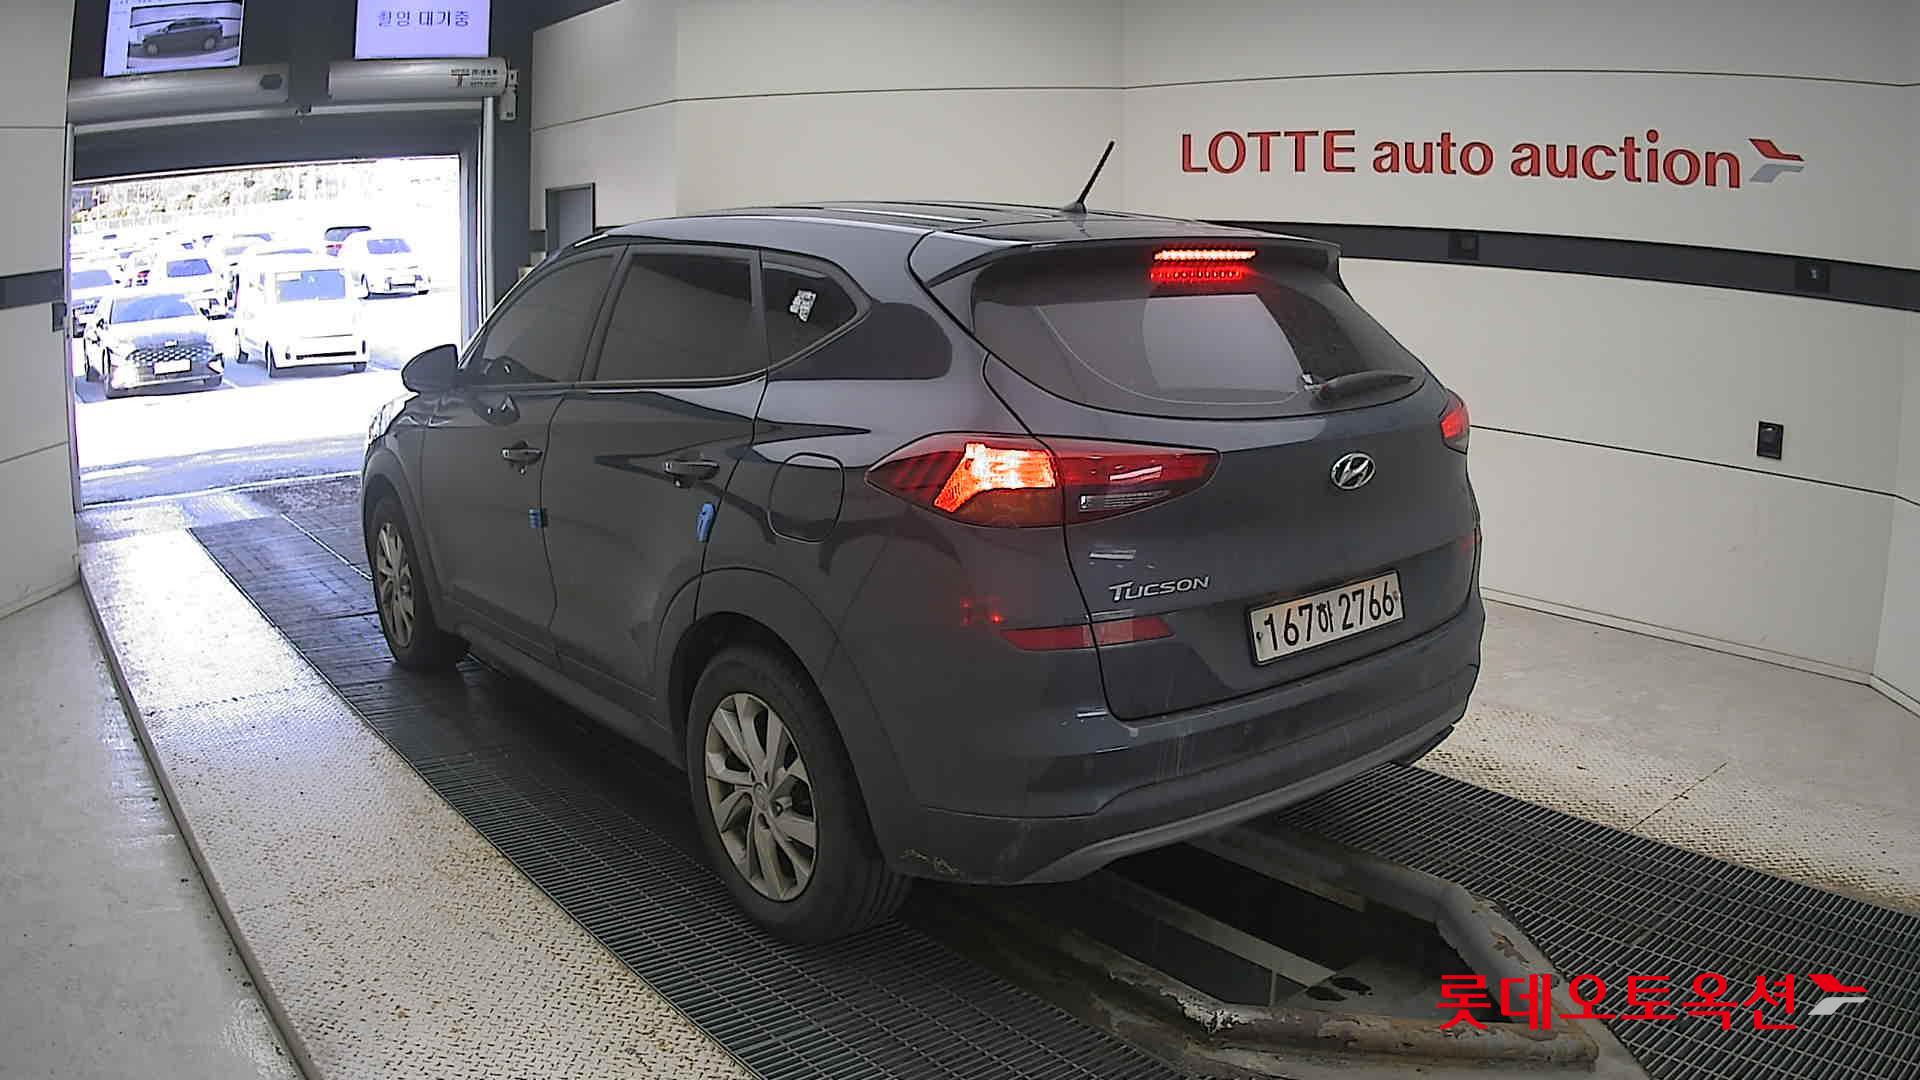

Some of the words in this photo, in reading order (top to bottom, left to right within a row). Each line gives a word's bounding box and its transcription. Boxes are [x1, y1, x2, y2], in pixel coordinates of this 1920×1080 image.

[1181, 130, 1356, 174] LOTTE
[1372, 131, 1494, 175] auto
[1510, 129, 1741, 188] auction
[1108, 576, 1209, 601] TUCSON
[1338, 581, 1395, 631] 2766
